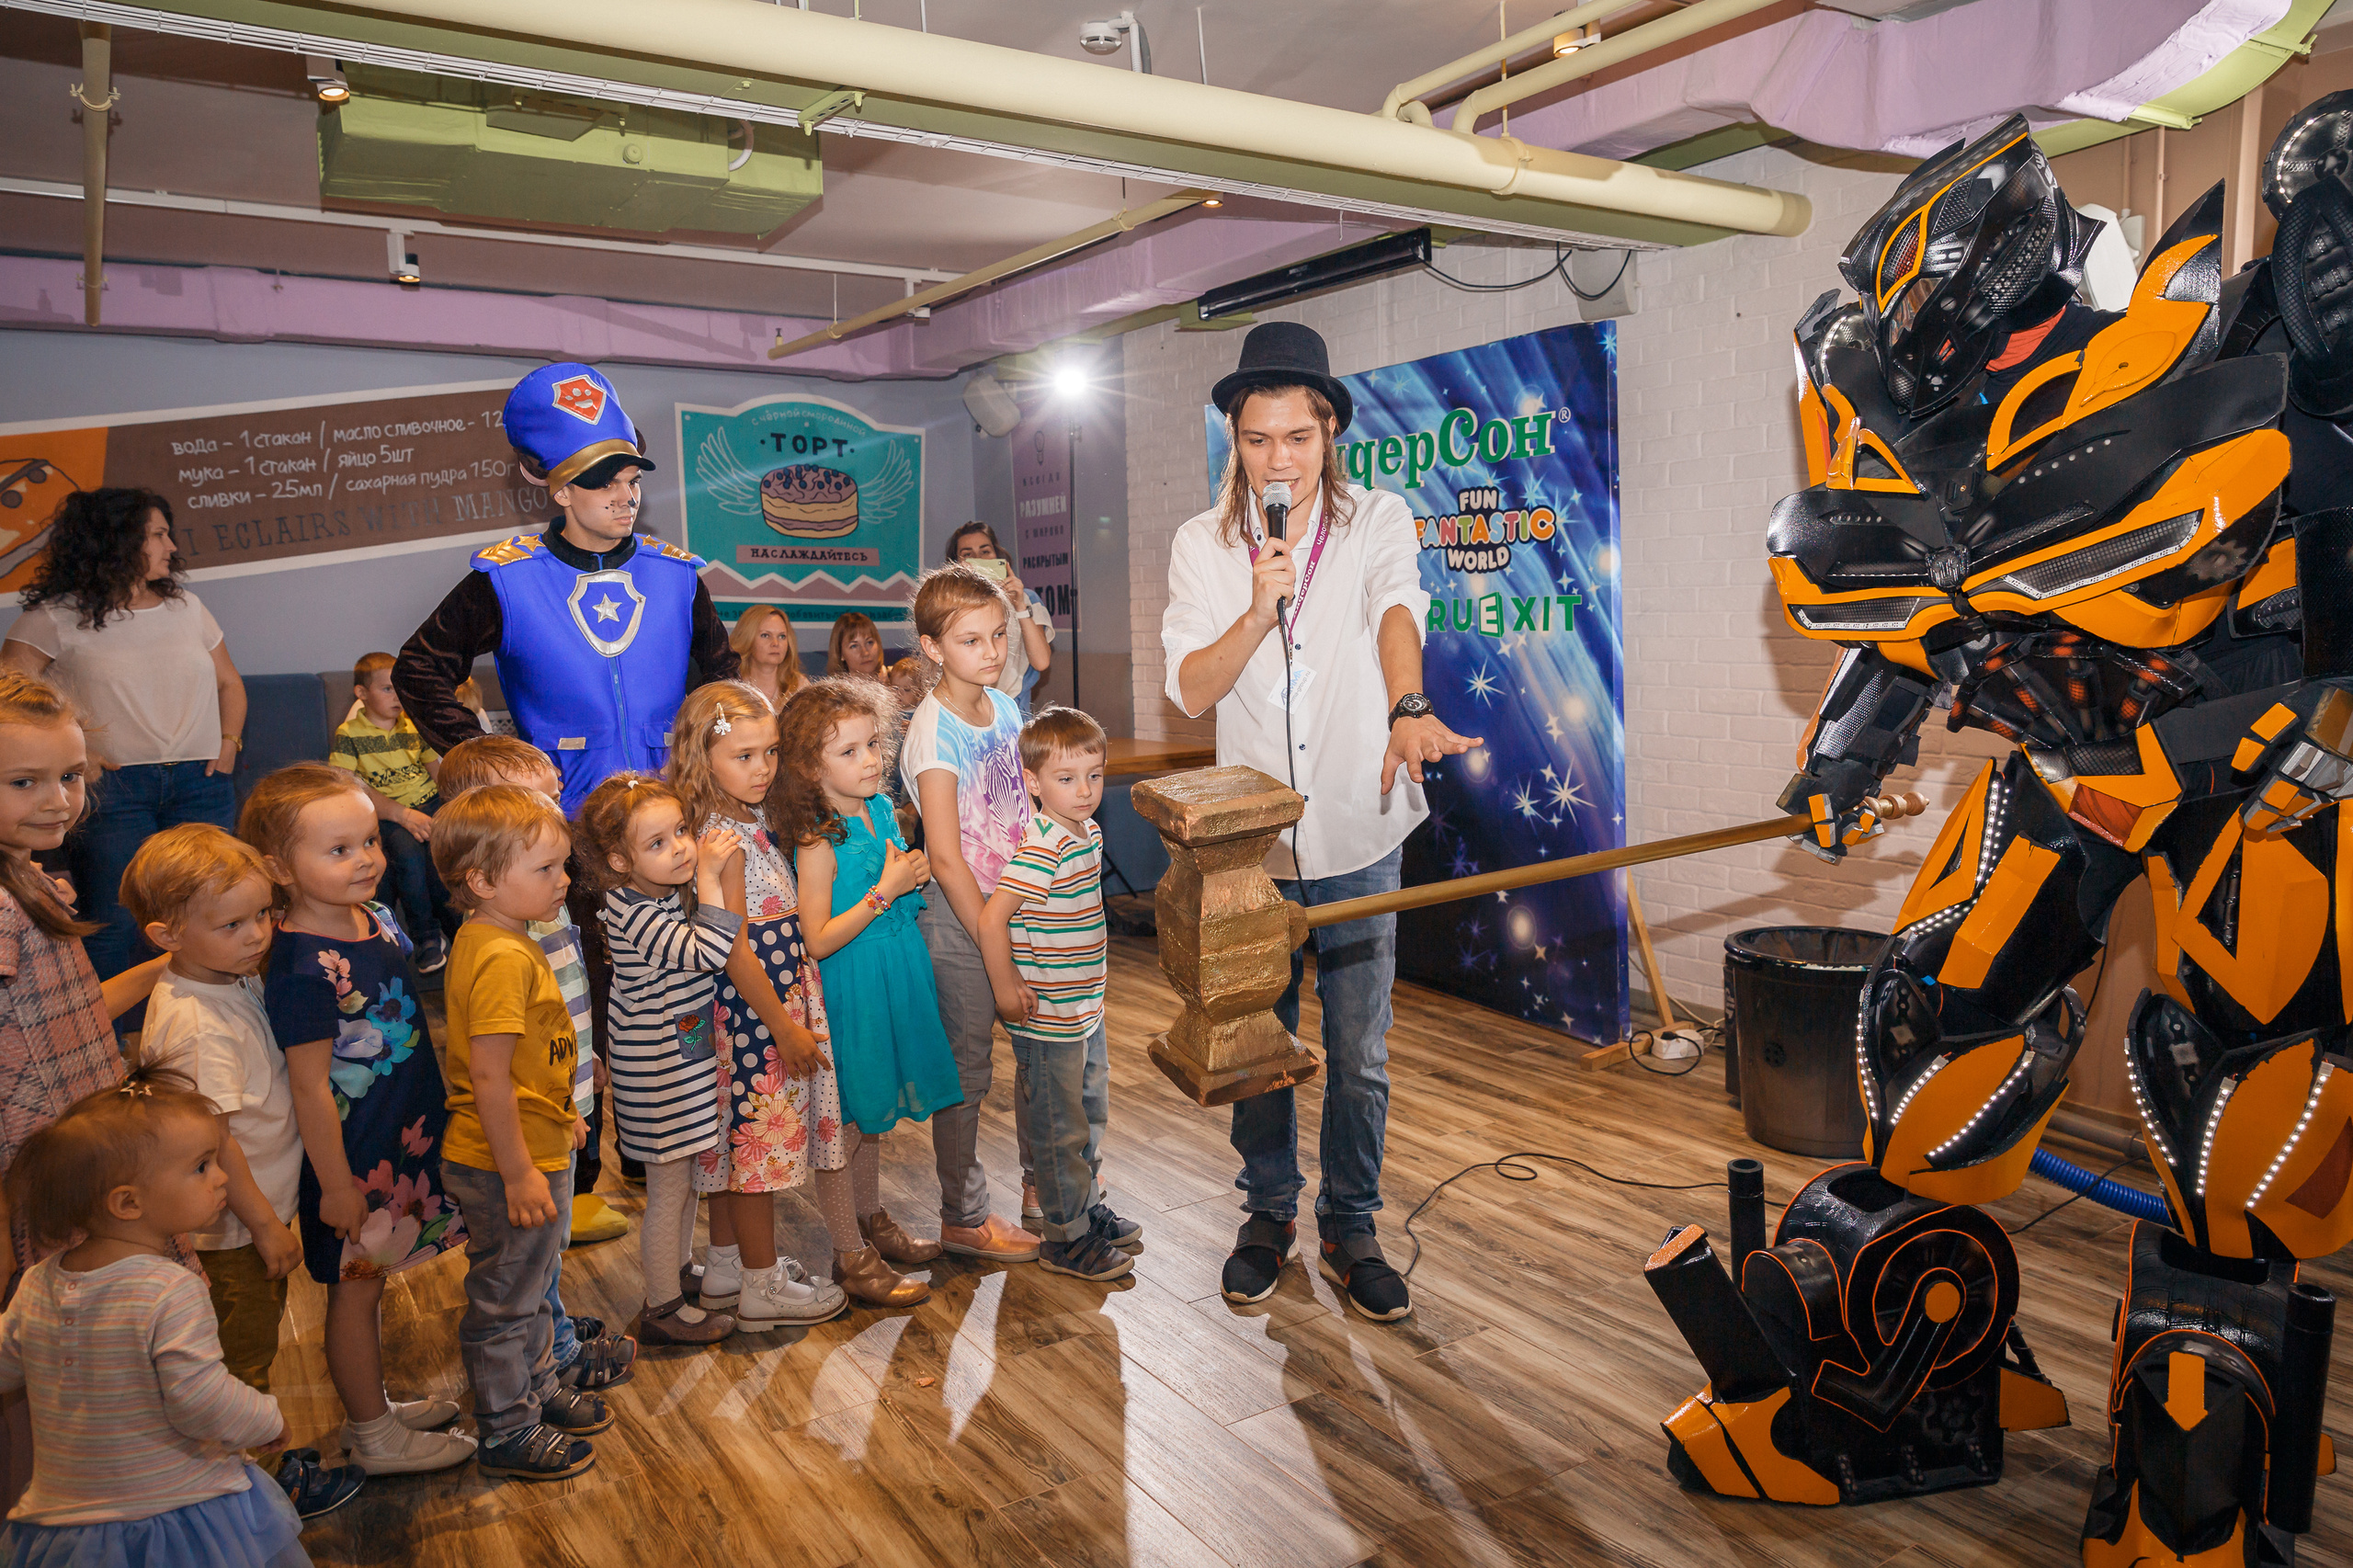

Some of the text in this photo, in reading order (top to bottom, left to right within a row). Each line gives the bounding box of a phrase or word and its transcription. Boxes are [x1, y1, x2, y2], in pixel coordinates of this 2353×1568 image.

[171, 438, 218, 456] вода
[254, 431, 312, 449] стакан
[333, 426, 381, 443] масло
[384, 418, 466, 437] сливочное
[801, 410, 867, 437] смородиной
[770, 432, 848, 458] ТОРТ
[178, 466, 224, 488] мука
[258, 457, 317, 476] стакан
[338, 450, 377, 468] яйцо
[188, 491, 252, 509] сливки
[271, 479, 323, 498] 25мл
[346, 472, 416, 495] сахарная
[420, 467, 468, 489] пудра
[470, 460, 516, 478] 150г
[1459, 489, 1497, 512] FUN
[212, 510, 351, 552] ECLAIRS
[358, 496, 443, 532] WITH
[451, 486, 549, 522] MANGO
[1414, 507, 1555, 549] FANTASTIC
[750, 548, 868, 562] НАСЛАЖДАЙТЕСЬ
[1447, 546, 1510, 571] WORLD
